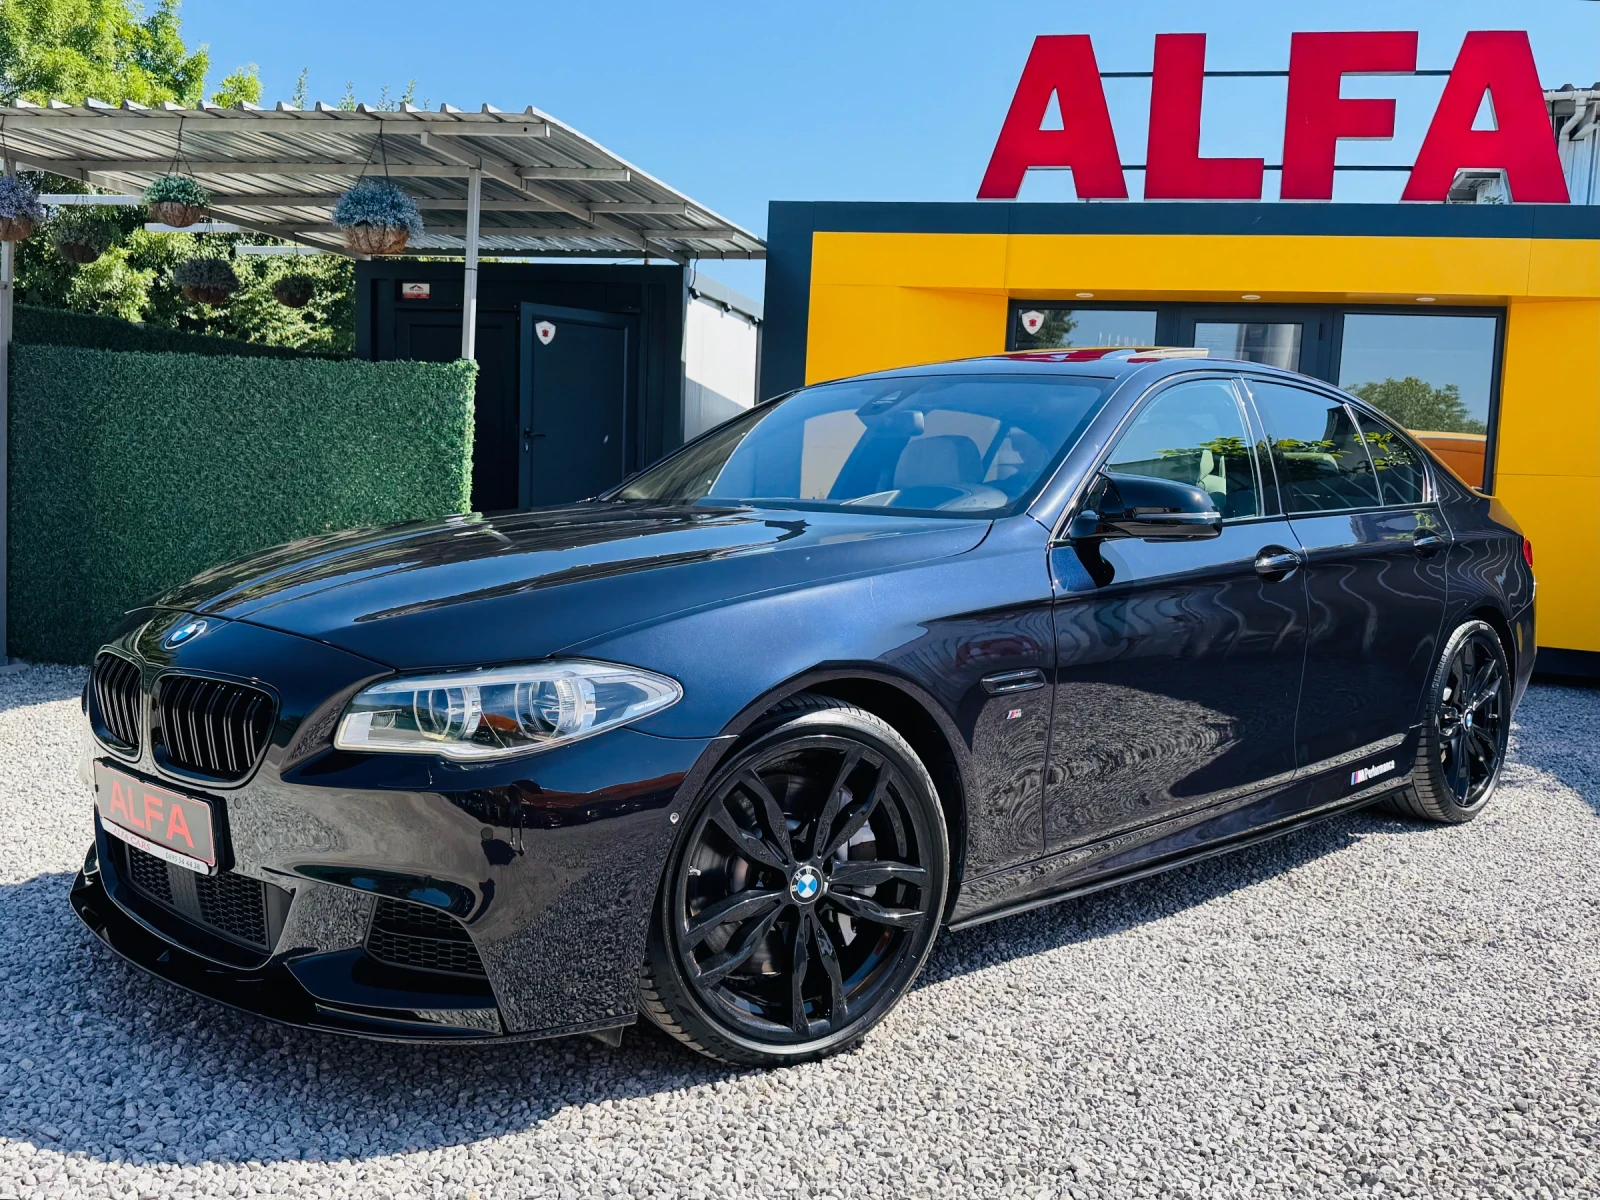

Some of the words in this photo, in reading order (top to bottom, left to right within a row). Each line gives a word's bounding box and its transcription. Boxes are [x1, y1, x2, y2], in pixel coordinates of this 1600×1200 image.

[976, 30, 1571, 204] ALFA
[109, 780, 195, 849] ALFA
[112, 827, 129, 841] ALFA
[130, 836, 151, 851] CARS
[790, 867, 812, 892] BMW
